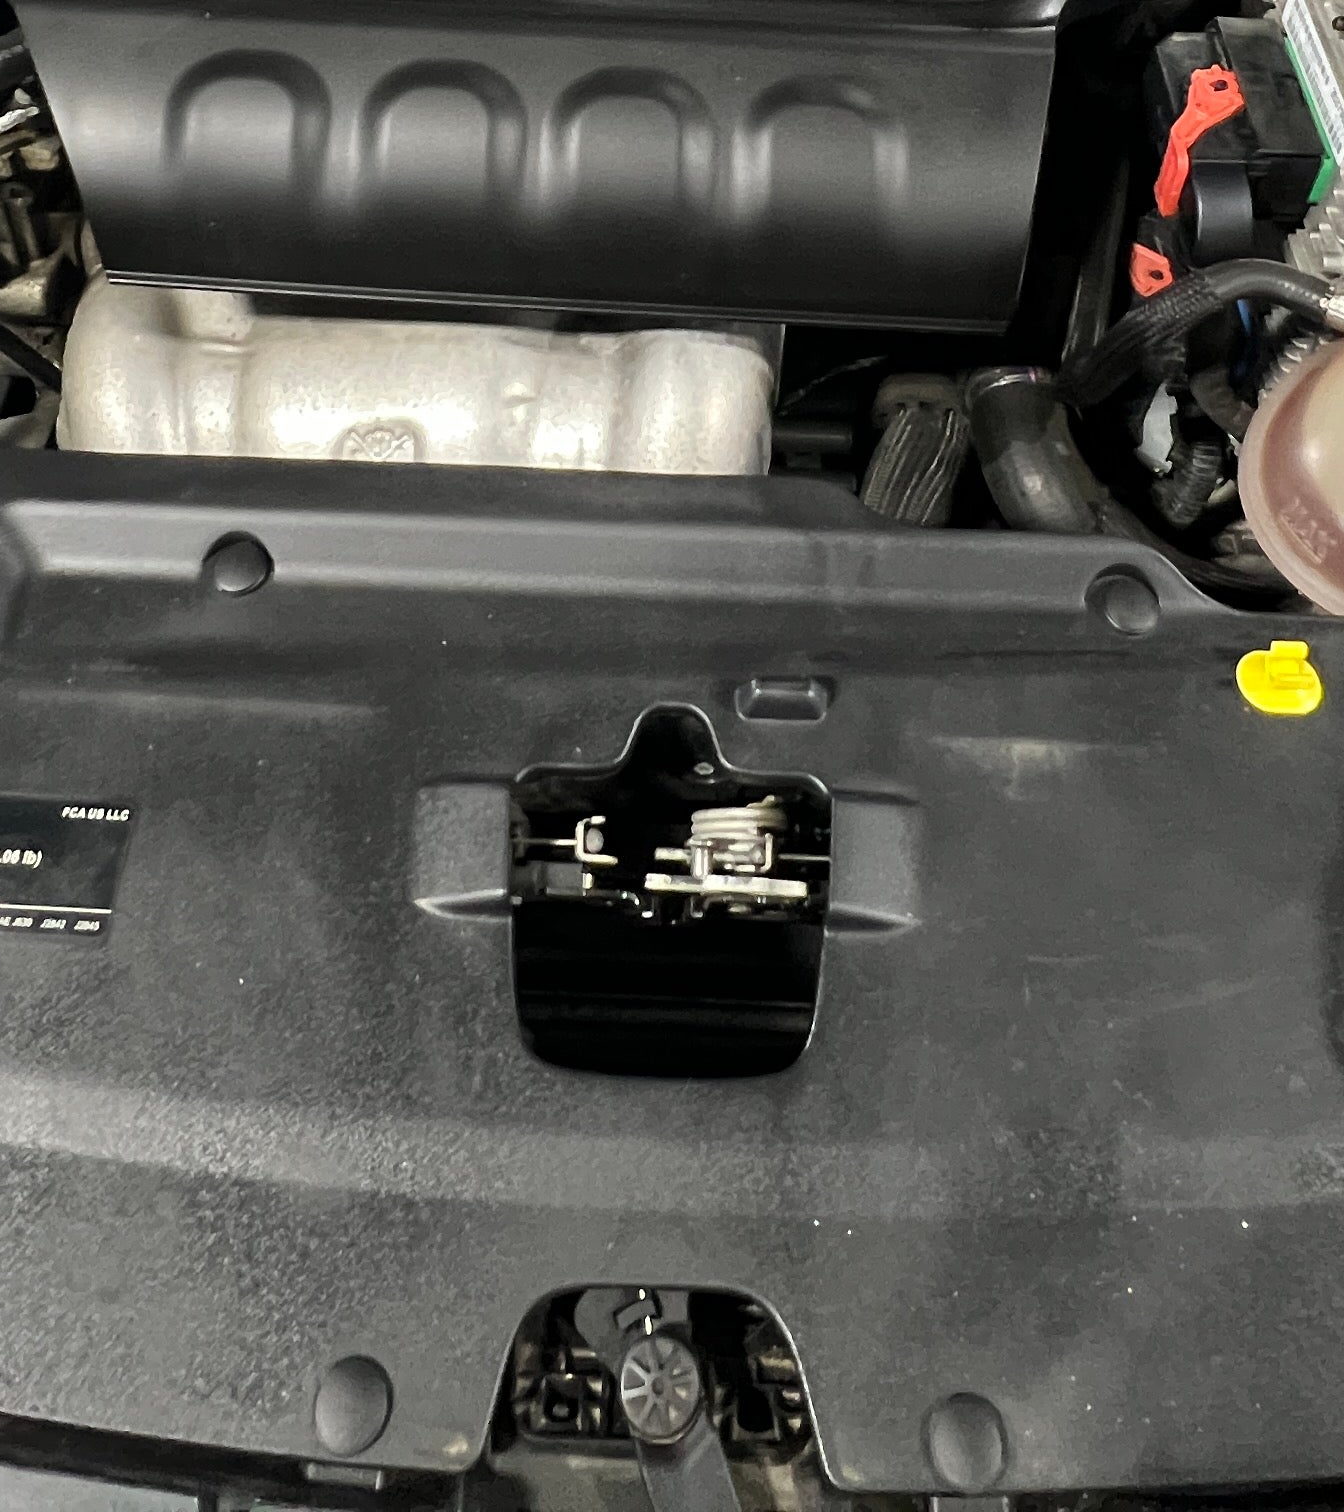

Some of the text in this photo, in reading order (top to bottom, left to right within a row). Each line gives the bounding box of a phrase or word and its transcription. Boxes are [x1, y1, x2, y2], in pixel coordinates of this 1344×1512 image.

[61, 806, 130, 822] FCA US LLC
[22, 849, 43, 870] lb)
